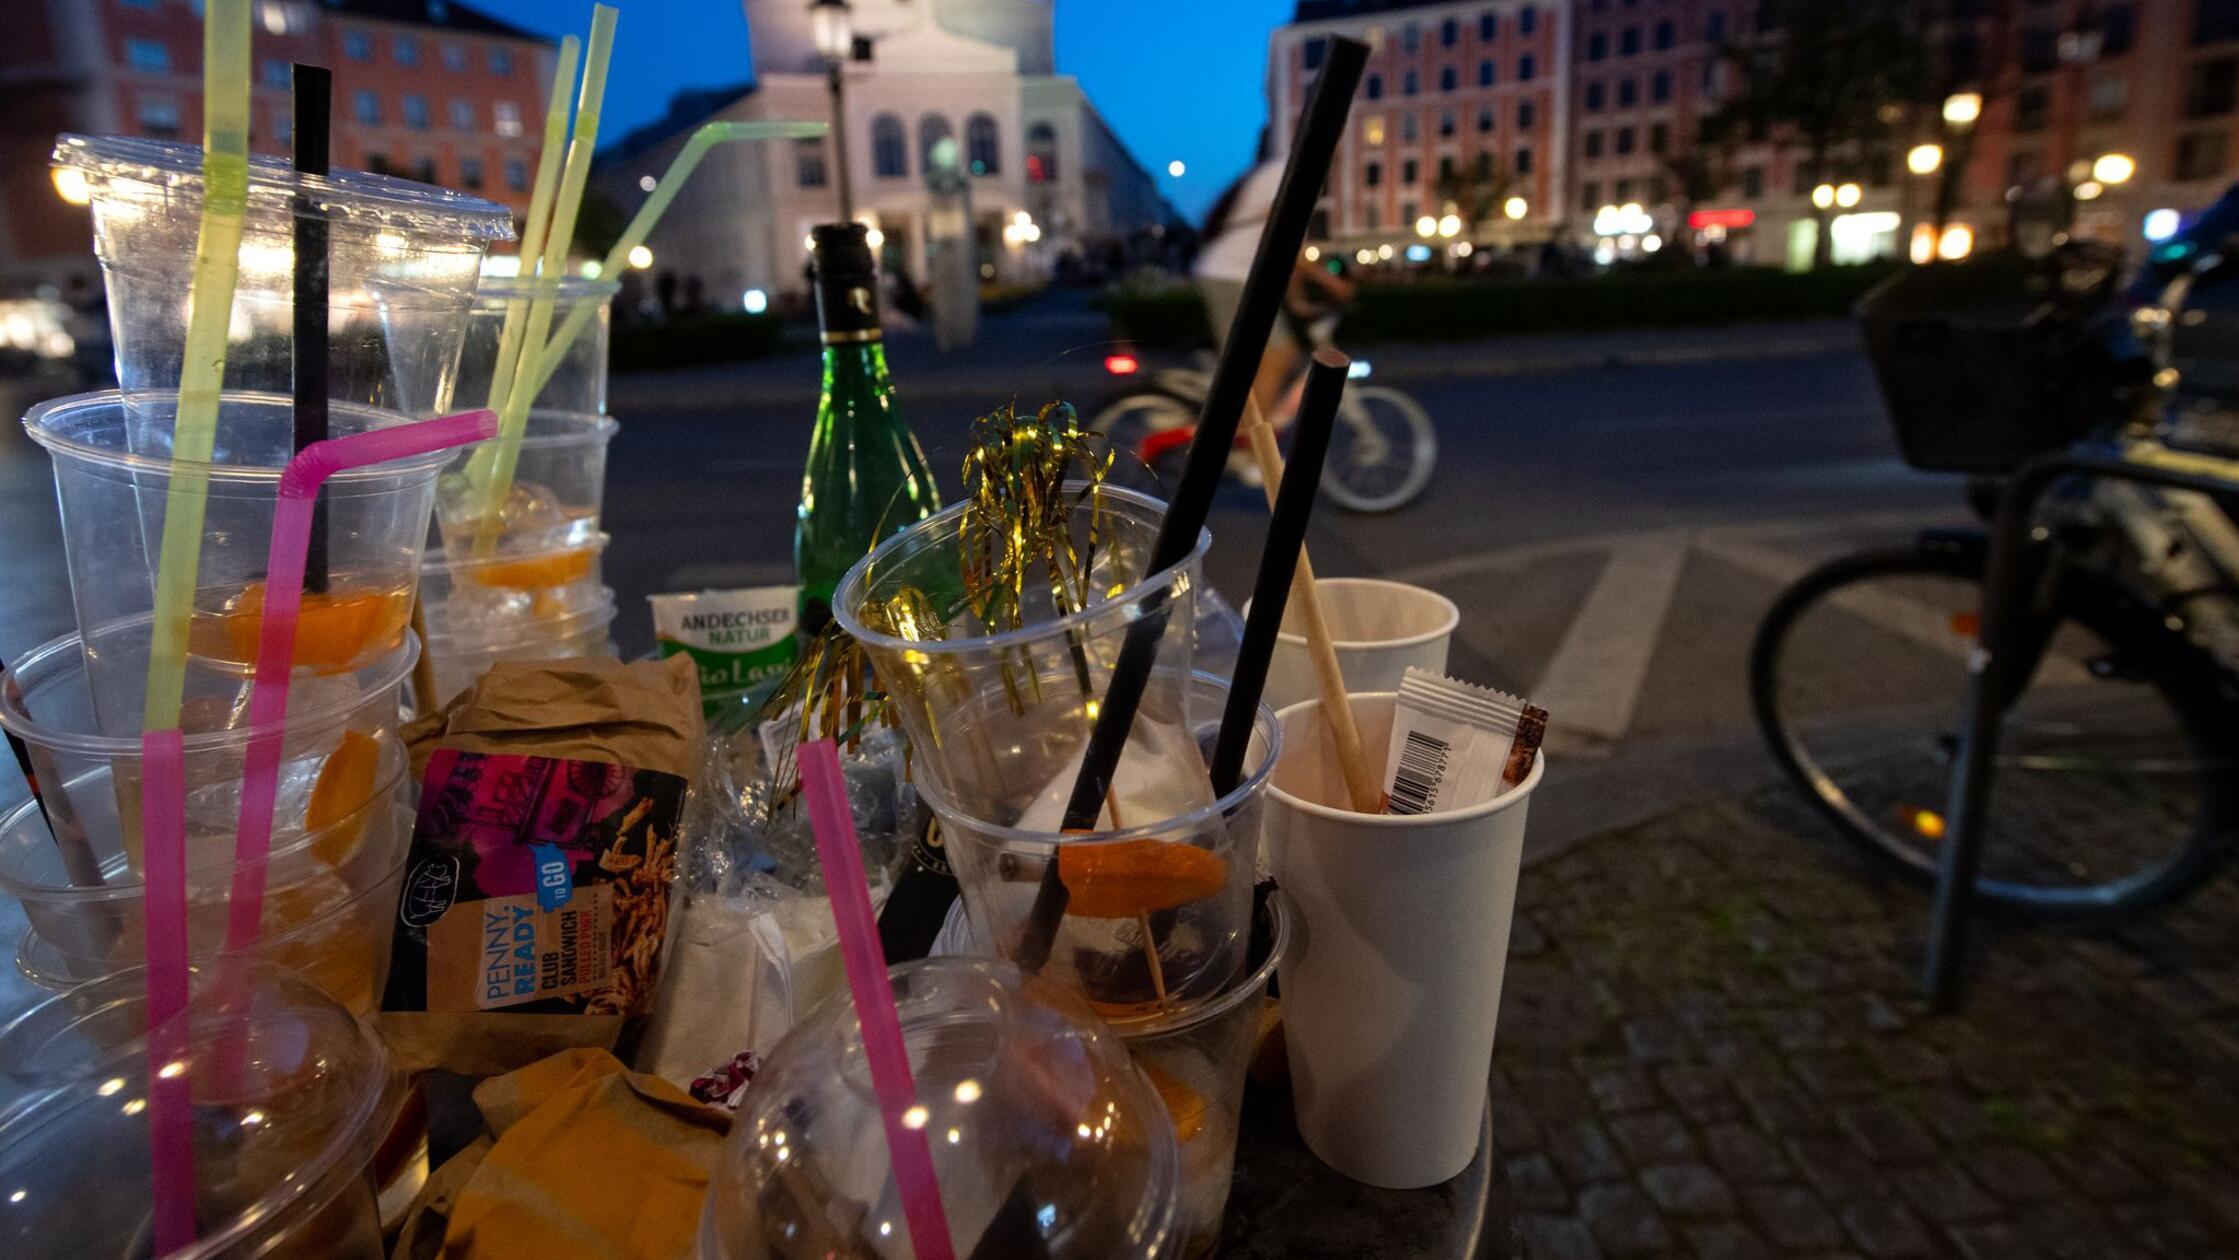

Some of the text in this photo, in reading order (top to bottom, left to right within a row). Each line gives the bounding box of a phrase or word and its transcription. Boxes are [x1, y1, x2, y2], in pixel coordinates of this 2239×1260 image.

[681, 609, 789, 629] ANDECHSER
[709, 627, 769, 644] NATUR
[541, 861, 566, 887] GO
[486, 905, 511, 999] PENNY.
[513, 905, 535, 994] READY
[542, 952, 560, 990] CLUB
[561, 910, 577, 986] SANDWICH
[579, 911, 592, 984] PULLED PORK
